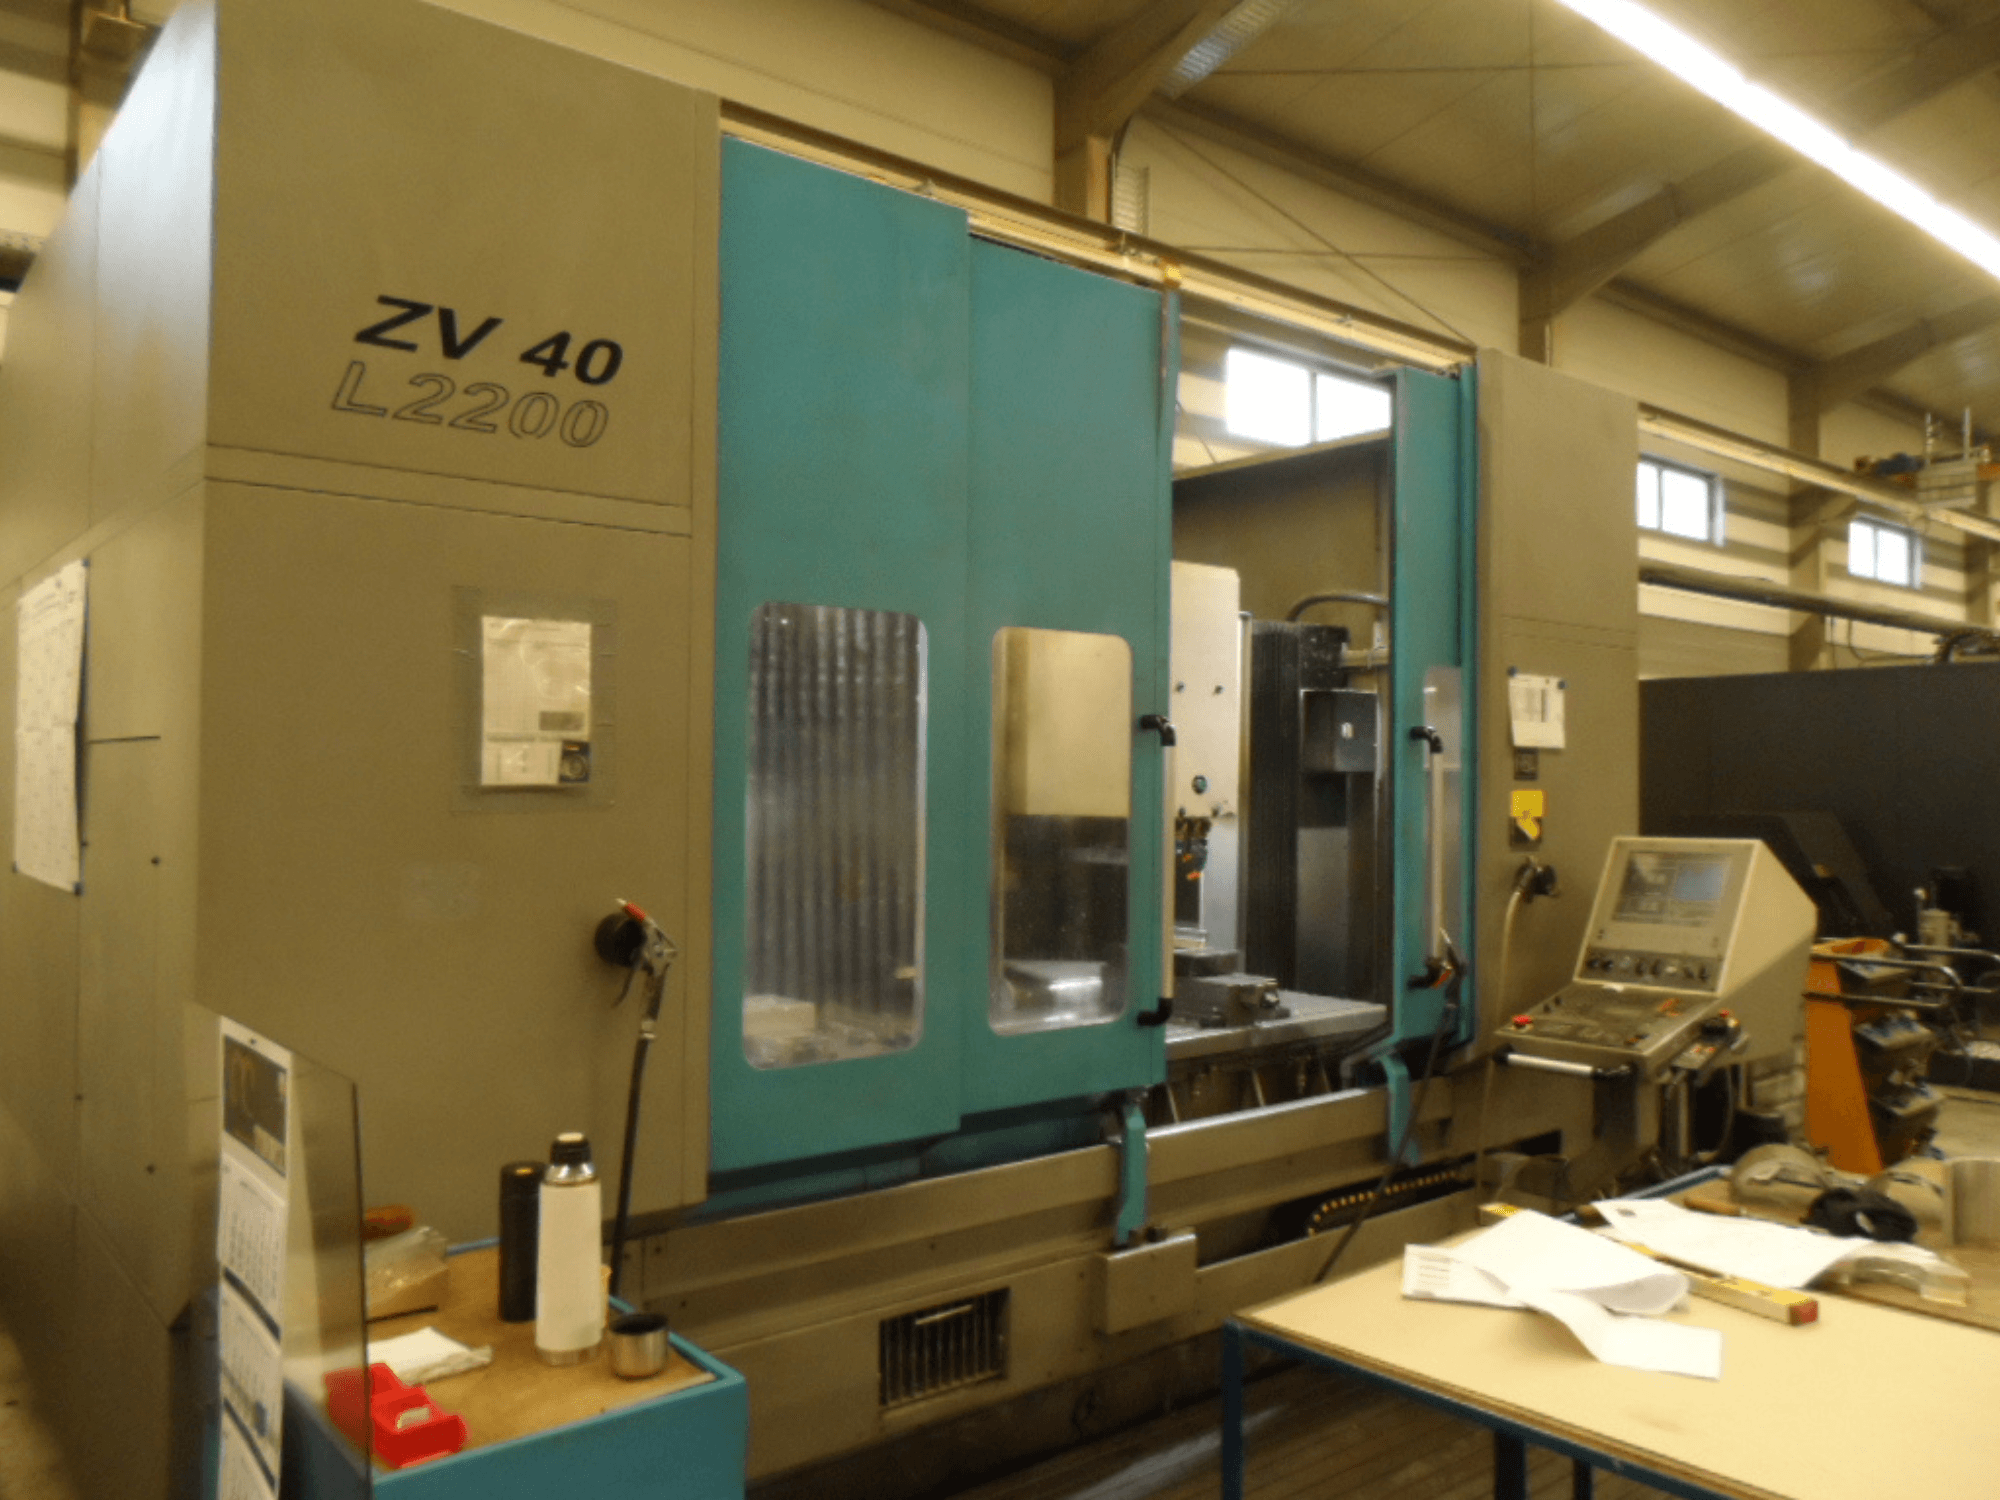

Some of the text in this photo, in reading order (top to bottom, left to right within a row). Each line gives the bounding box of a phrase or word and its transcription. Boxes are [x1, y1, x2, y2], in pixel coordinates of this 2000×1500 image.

[354, 294, 623, 386] ZV 40
[331, 360, 609, 448] L2200
